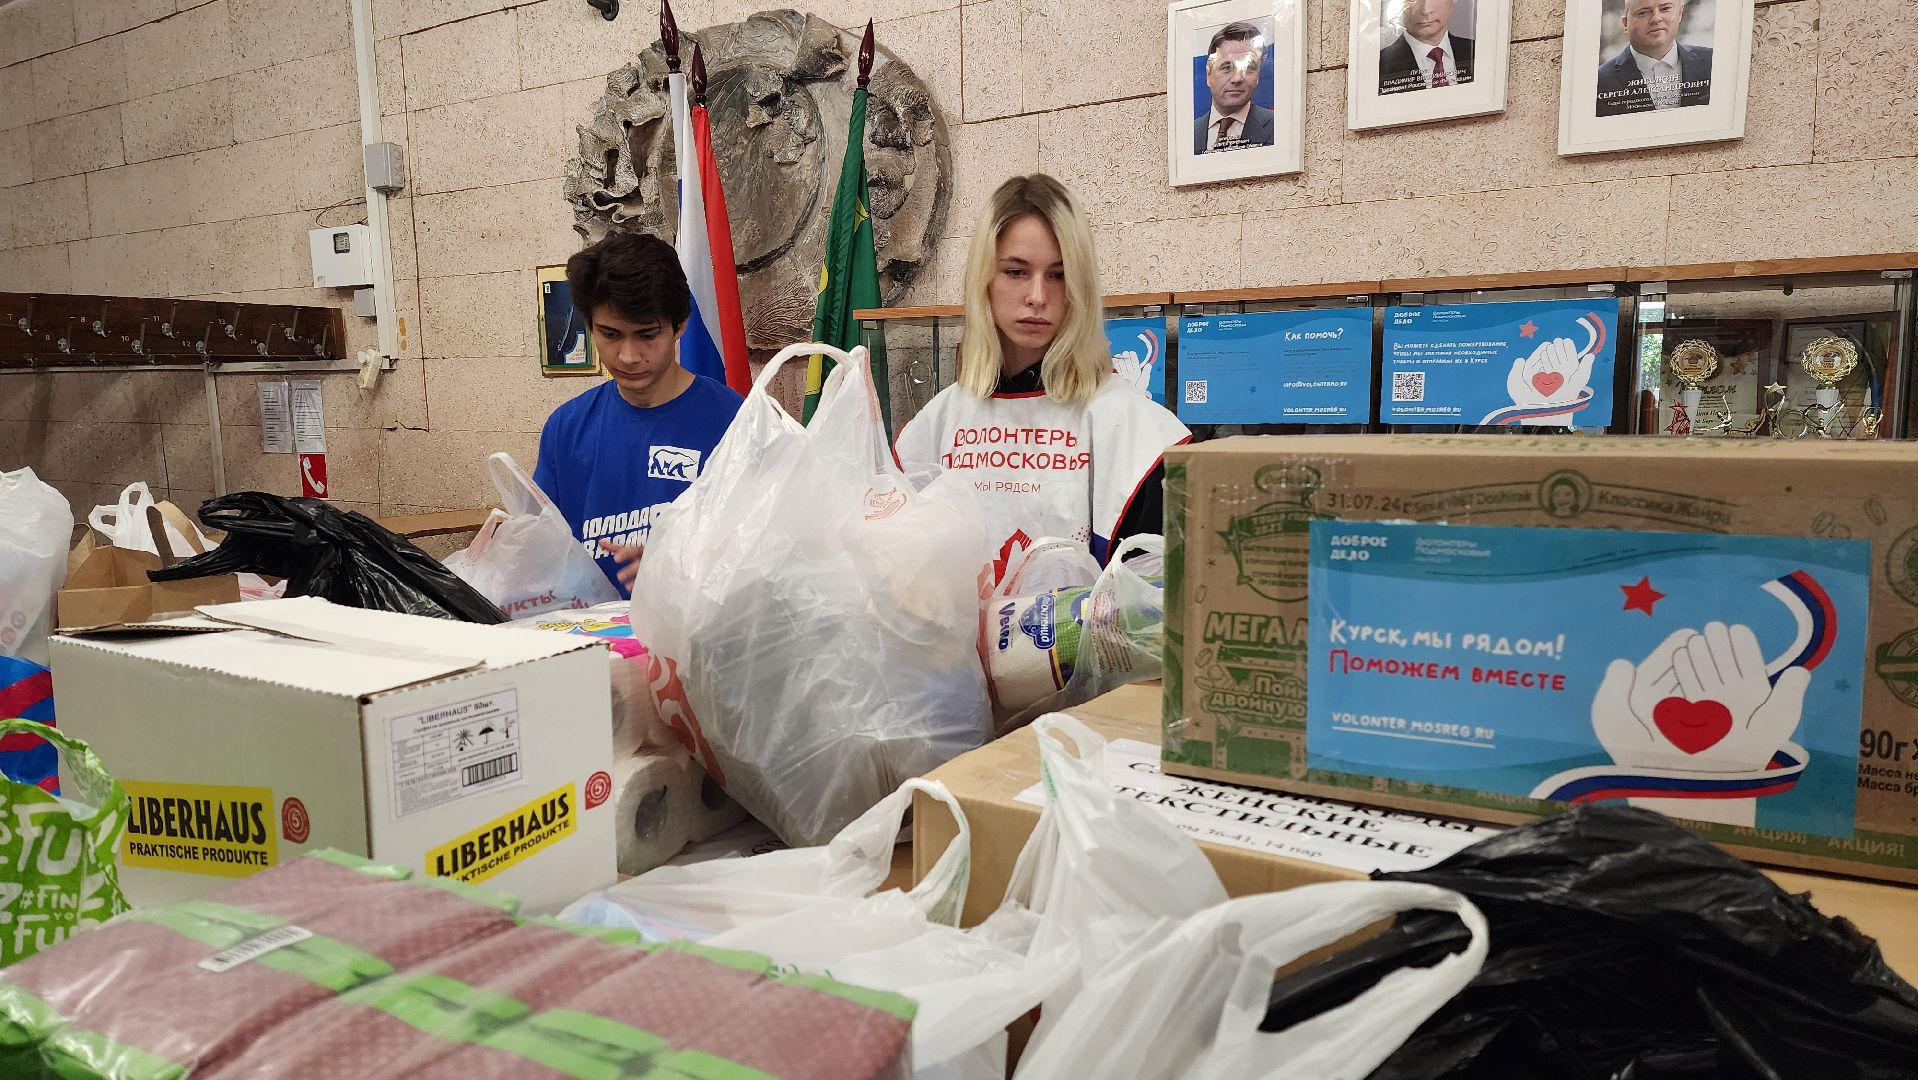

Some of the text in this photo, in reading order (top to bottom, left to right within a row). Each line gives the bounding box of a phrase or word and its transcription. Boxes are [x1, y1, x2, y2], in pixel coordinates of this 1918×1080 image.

[1598, 88, 1630, 100] СЕРГЕЙ
[1630, 80, 1710, 96] АЛЕКСАНДРОВИЧ
[974, 481, 1041, 493] МЫ РЯДОМ
[1330, 549, 1369, 560] ДЕЛО
[1331, 535, 1388, 547] ДОБРОЕ
[499, 589, 557, 619] УКТЫ
[1203, 611, 1288, 644] МЕГА
[1329, 648, 1567, 691] Поможем вместе
[1331, 711, 1495, 740] VOLONTER.MOSREG.RU
[1857, 776, 1902, 792] Масса
[1858, 763, 1903, 779] Масса
[127, 796, 267, 845] LIBERHAUS
[1115, 785, 1432, 858] ТЕКСТИЛЬНЫЕ
[1174, 783, 1385, 833] ЖЕНСКИЕ
[436, 793, 570, 877] LIBERHAUS
[129, 842, 269, 866] PRAKTISCHE PRODUKTE
[456, 819, 570, 883] KTISCHE PRODUKTE
